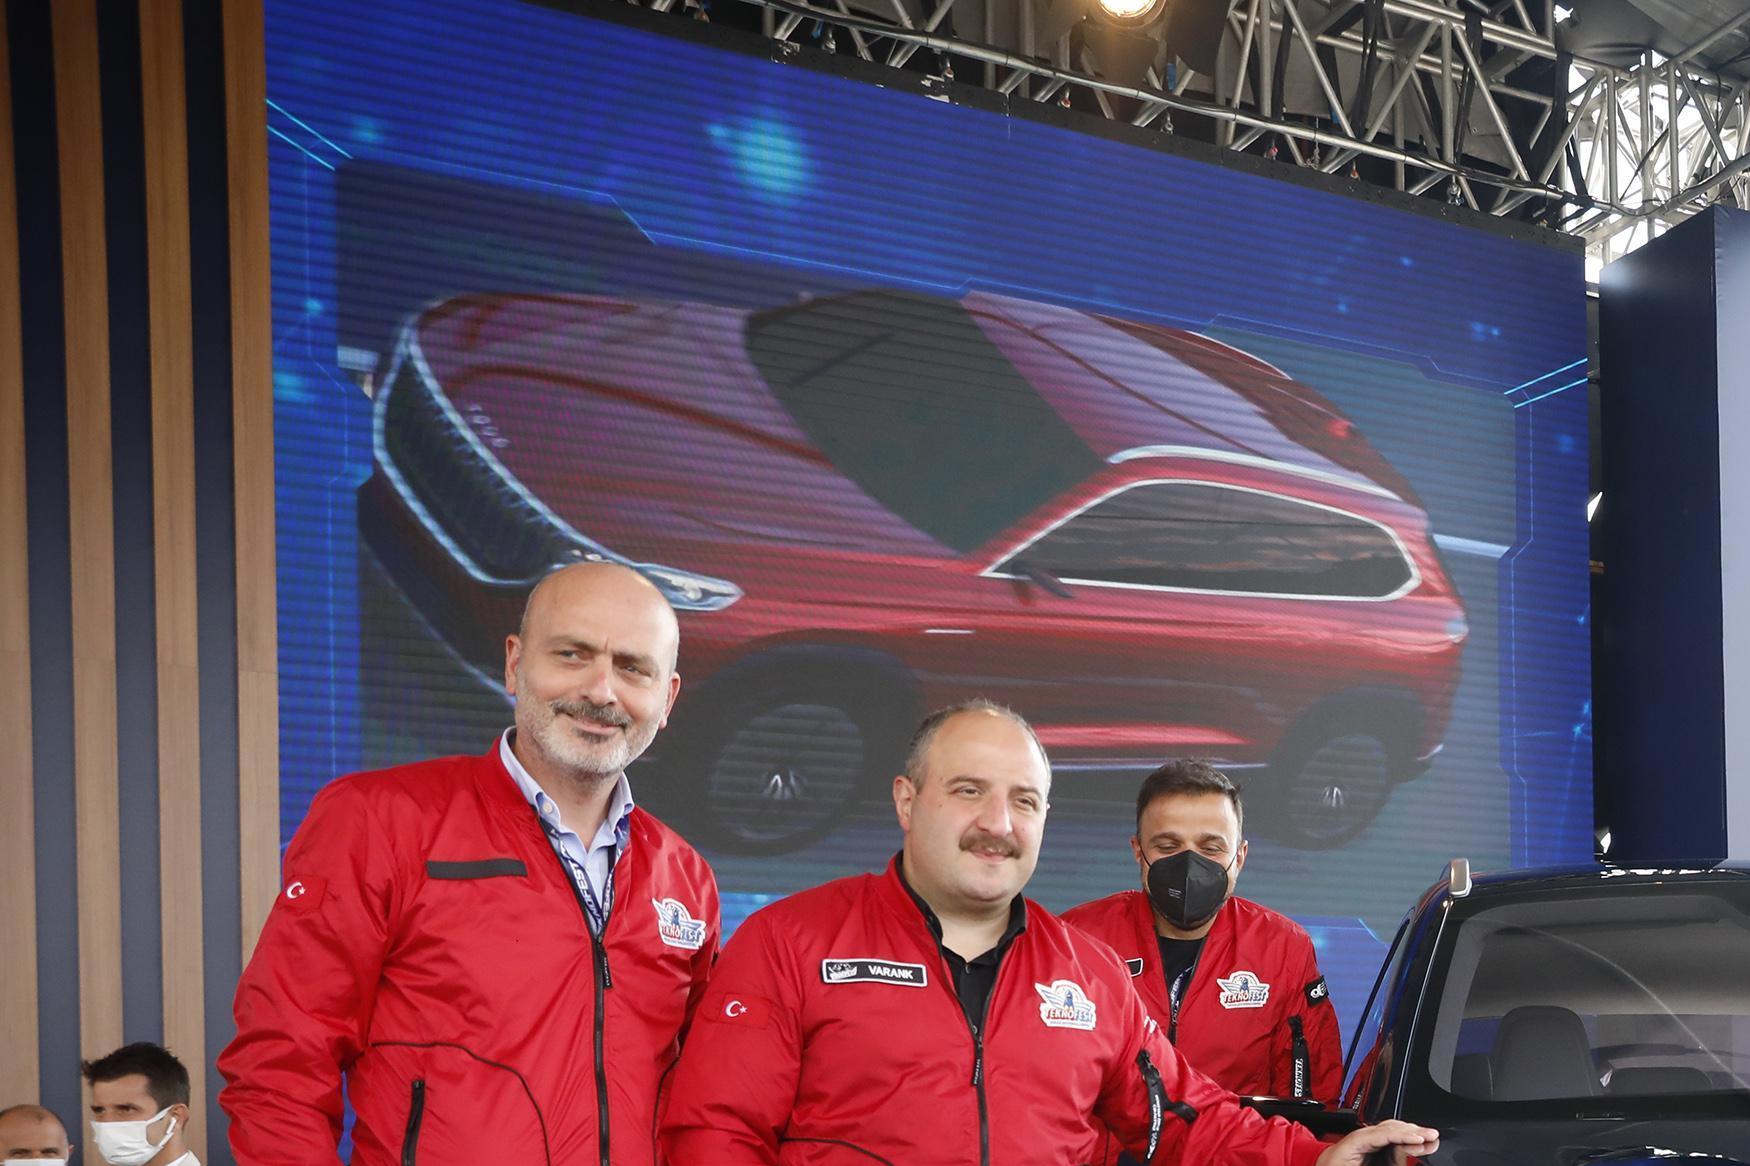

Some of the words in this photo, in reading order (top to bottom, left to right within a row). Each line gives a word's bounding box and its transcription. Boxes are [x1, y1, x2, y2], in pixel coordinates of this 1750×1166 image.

[867, 965, 914, 979] VARANK
[1222, 991, 1267, 1004] TEKNOFEST
[1044, 1006, 1094, 1023] TEKNOFEST
[1294, 1058, 1304, 1098] TEKNOFES
